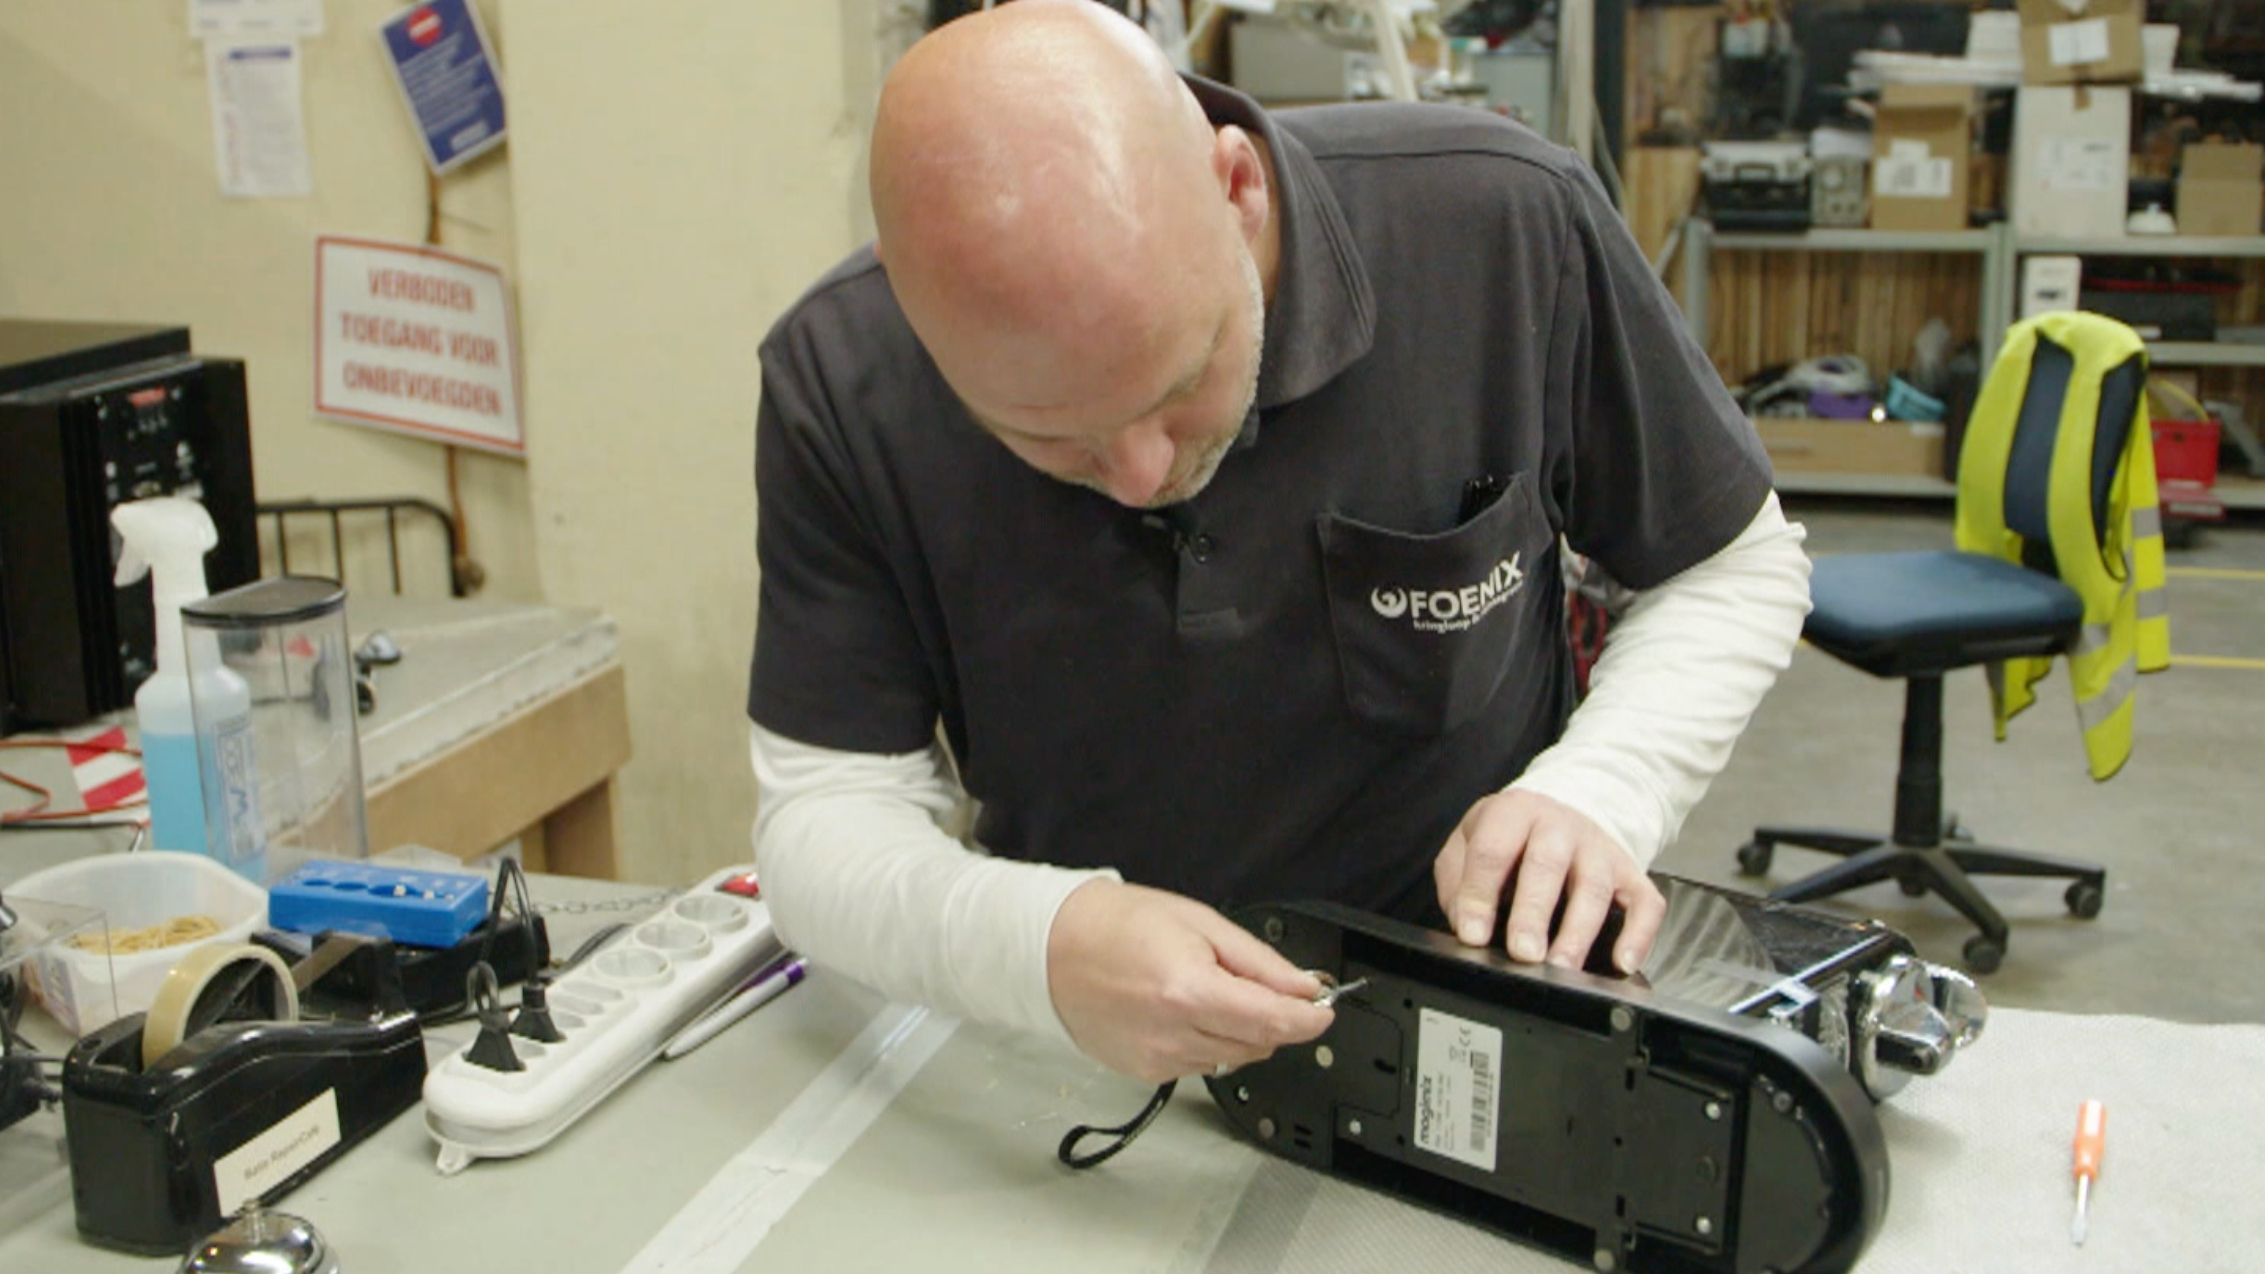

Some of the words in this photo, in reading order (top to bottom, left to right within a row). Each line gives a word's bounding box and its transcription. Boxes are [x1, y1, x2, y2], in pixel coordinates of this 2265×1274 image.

[369, 267, 475, 312] VERBODEN
[341, 311, 443, 356] TOEGANG
[450, 330, 499, 367] VOOR
[342, 360, 503, 416] ONBEVOEGDEN
[1410, 550, 1523, 620] FOENIX
